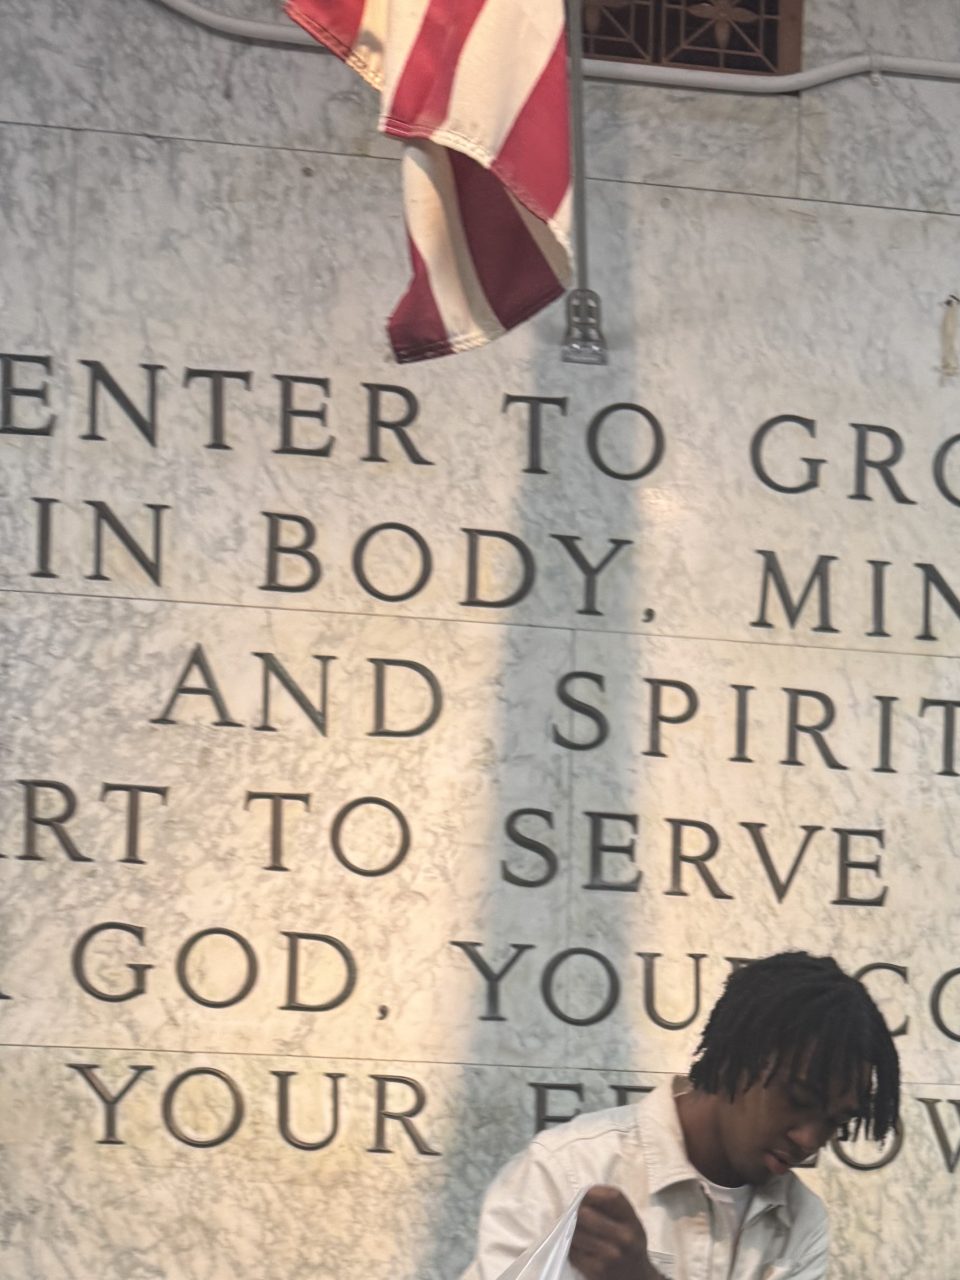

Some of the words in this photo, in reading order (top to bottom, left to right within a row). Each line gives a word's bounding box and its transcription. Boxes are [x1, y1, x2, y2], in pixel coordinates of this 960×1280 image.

[0, 352, 435, 466] ENTER
[503, 394, 666, 481] TO
[30, 497, 172, 588] IN
[258, 510, 656, 623] BODY,
[149, 642, 444, 738] AND
[0, 778, 170, 865] RT
[244, 790, 412, 878] TO
[502, 807, 888, 907] SERVE
[71, 920, 389, 1021] GOD,
[450, 940, 759, 1031] YOU
[66, 1062, 442, 1157] YOUR
